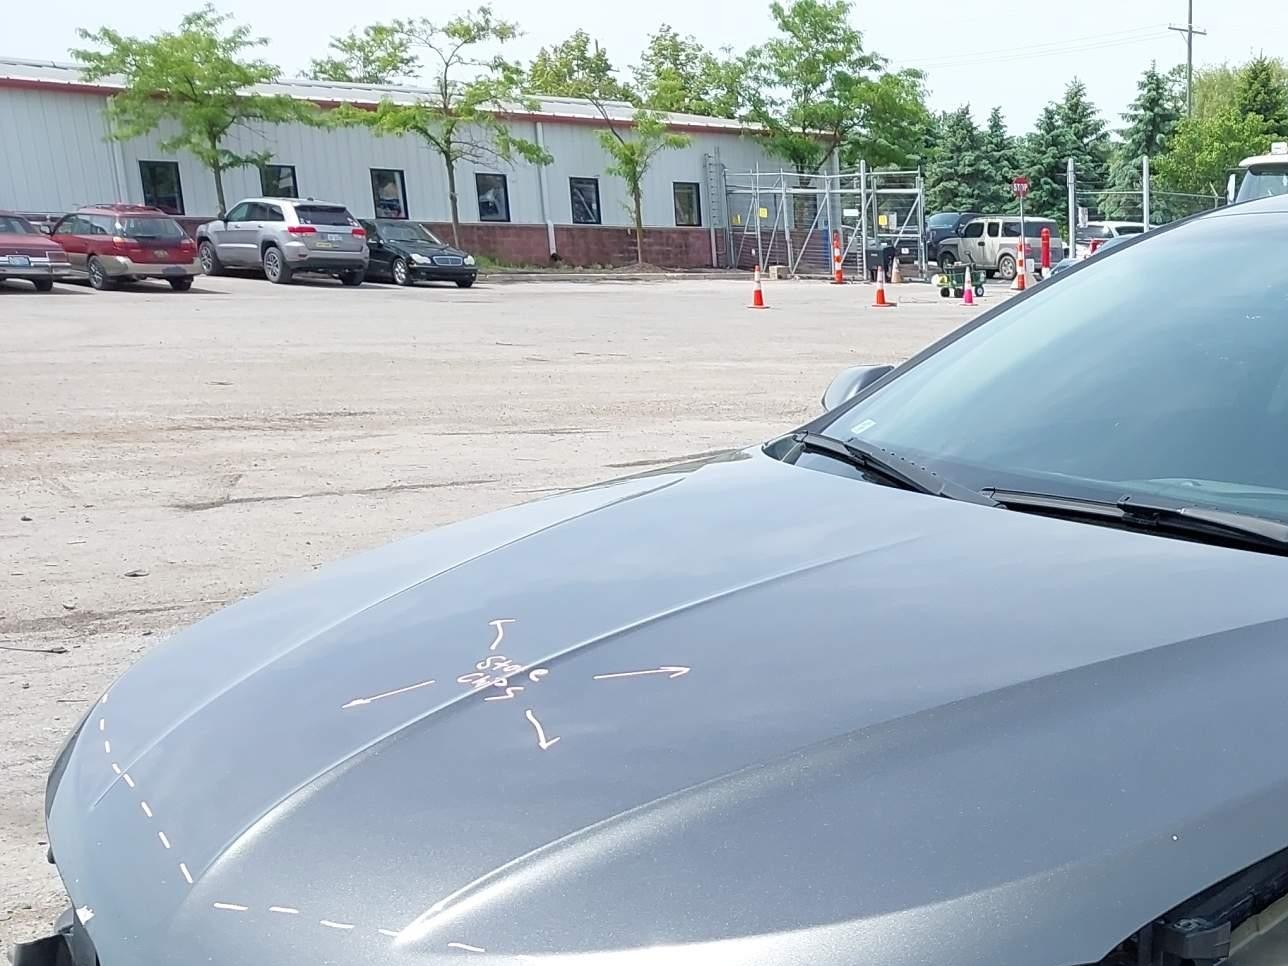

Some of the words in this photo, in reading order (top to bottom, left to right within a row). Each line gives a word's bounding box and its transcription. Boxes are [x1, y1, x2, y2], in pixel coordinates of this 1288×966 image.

[1013, 183, 1028, 192] STOP
[476, 655, 549, 683] Stoe
[456, 672, 525, 701] Chps
